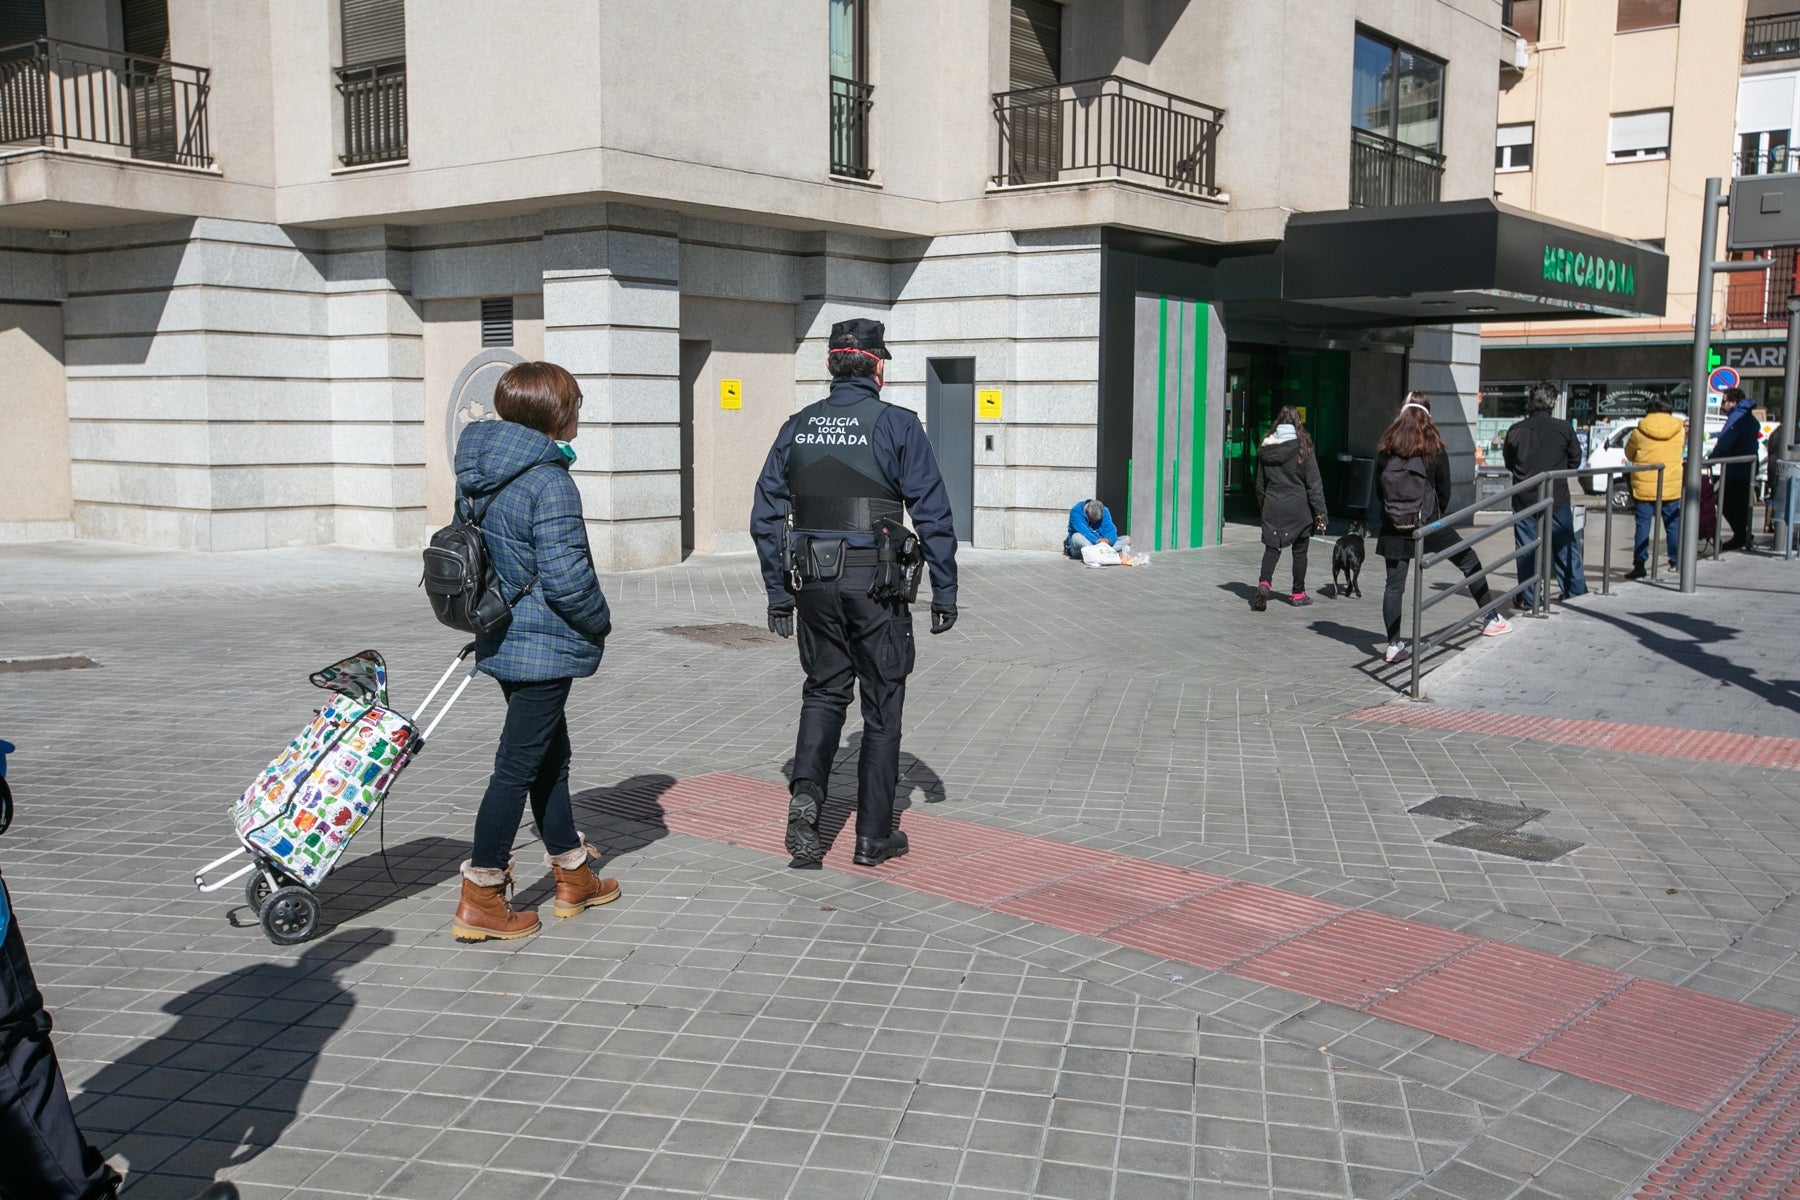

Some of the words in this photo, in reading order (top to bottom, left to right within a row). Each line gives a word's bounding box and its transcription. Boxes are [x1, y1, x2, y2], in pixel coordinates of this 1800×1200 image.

[1543, 244, 1635, 295] MERCADONA
[808, 416, 859, 427] POLICIA
[818, 426, 846, 434] LOCAL
[795, 433, 868, 446] GRANADA
